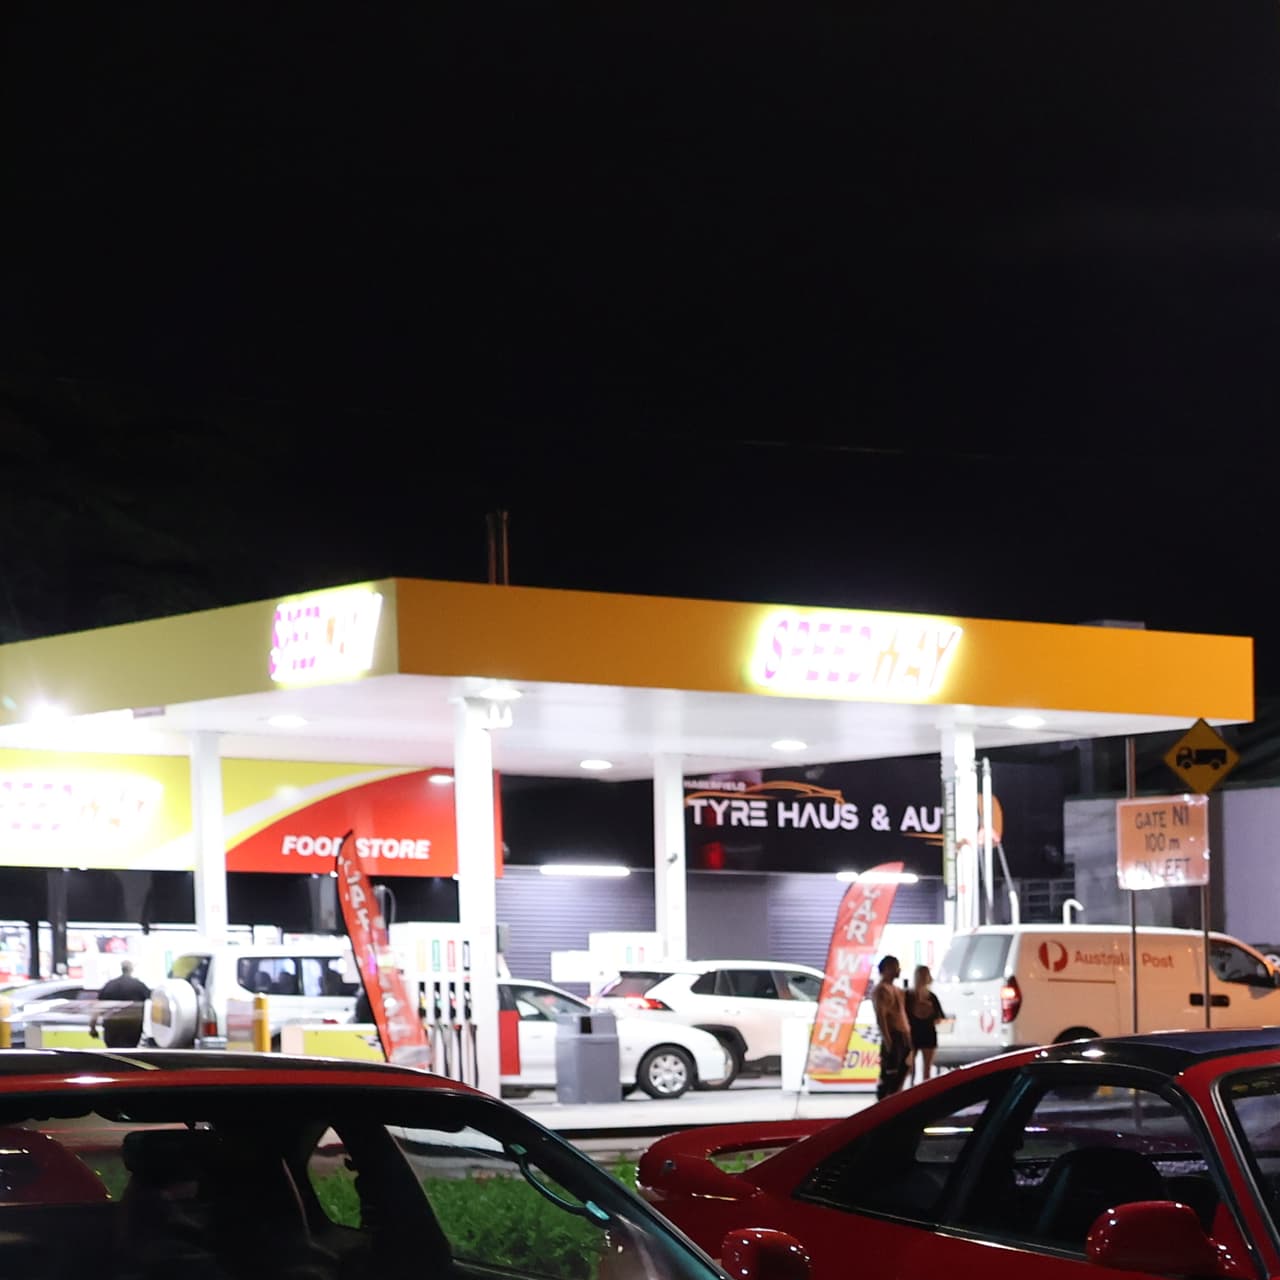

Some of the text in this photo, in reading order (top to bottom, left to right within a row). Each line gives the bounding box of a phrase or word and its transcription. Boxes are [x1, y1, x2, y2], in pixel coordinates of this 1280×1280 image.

[687, 798, 945, 833] TYRE HAUS & AU
[1135, 811, 1168, 830] GATE
[355, 837, 431, 860] STORE
[1145, 832, 1166, 852] 100
[1074, 950, 1175, 969] Australi Post
[819, 950, 861, 1043] WASH
